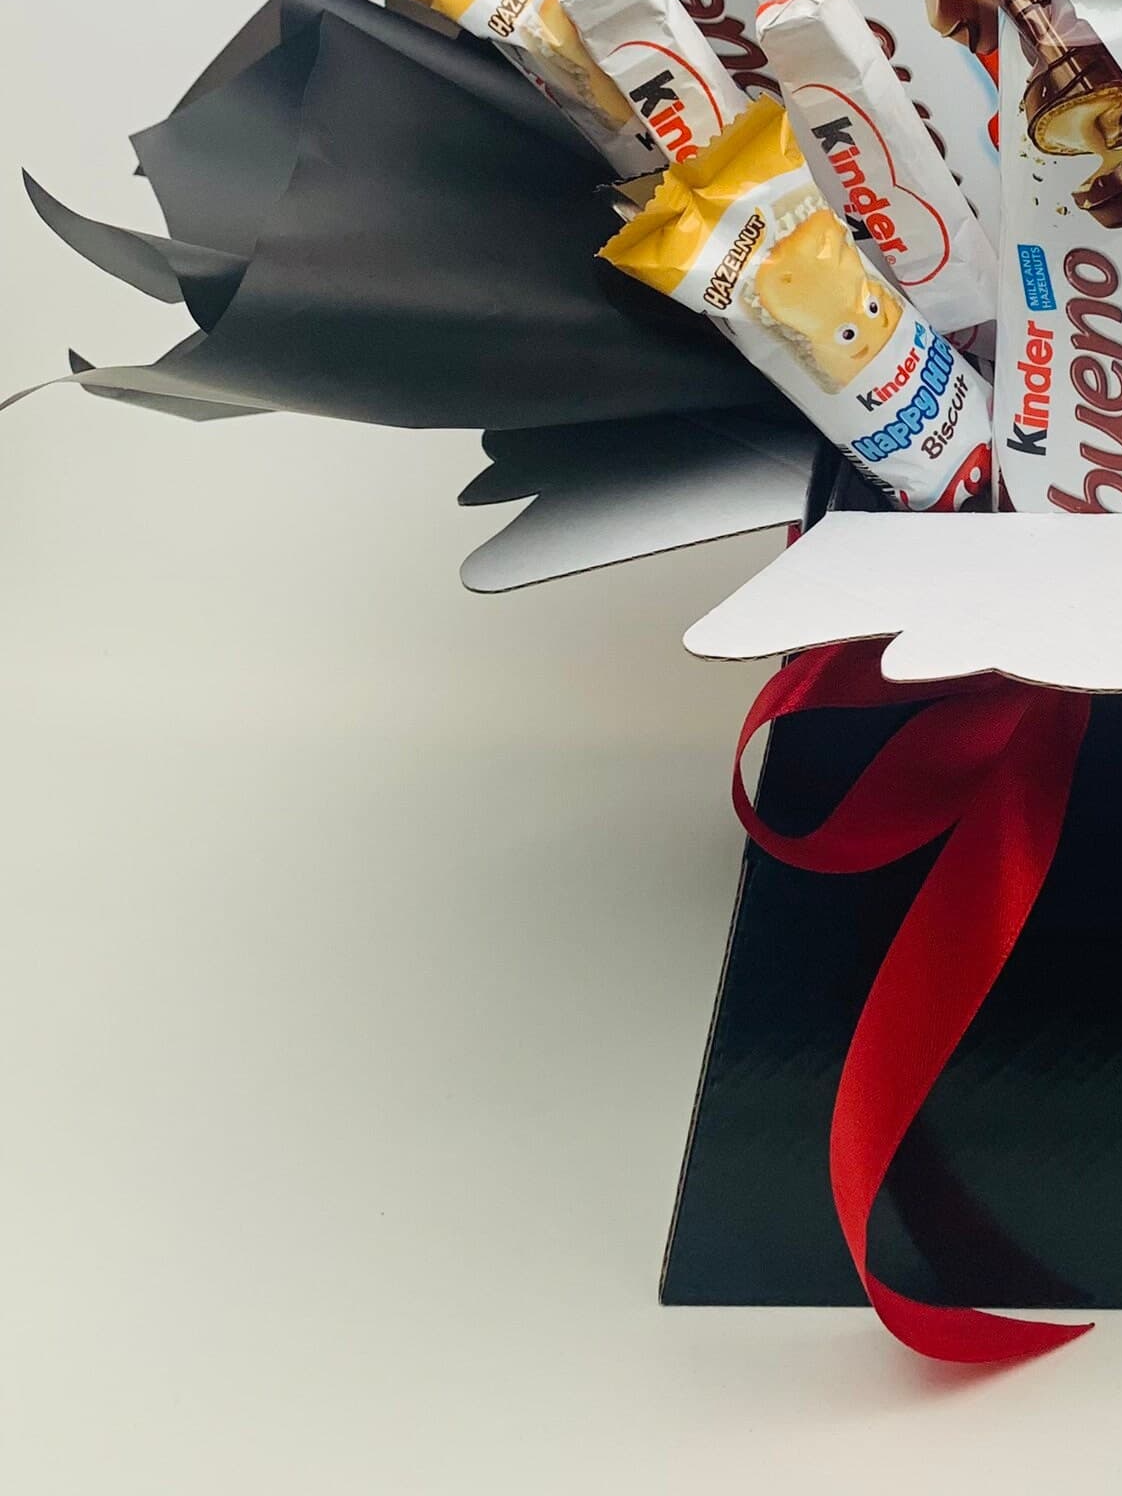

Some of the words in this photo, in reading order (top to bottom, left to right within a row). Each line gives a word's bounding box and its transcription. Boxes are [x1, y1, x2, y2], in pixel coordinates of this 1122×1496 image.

[811, 116, 908, 252] Kinder
[703, 214, 766, 310] HAZELNUT
[1021, 250, 1034, 277] AND
[1025, 278, 1041, 307] MILK
[1030, 247, 1052, 309] HAZELNUTS
[856, 347, 921, 412] Kinder
[920, 373, 969, 460] Biscuit
[1006, 319, 1055, 456] Kinder
